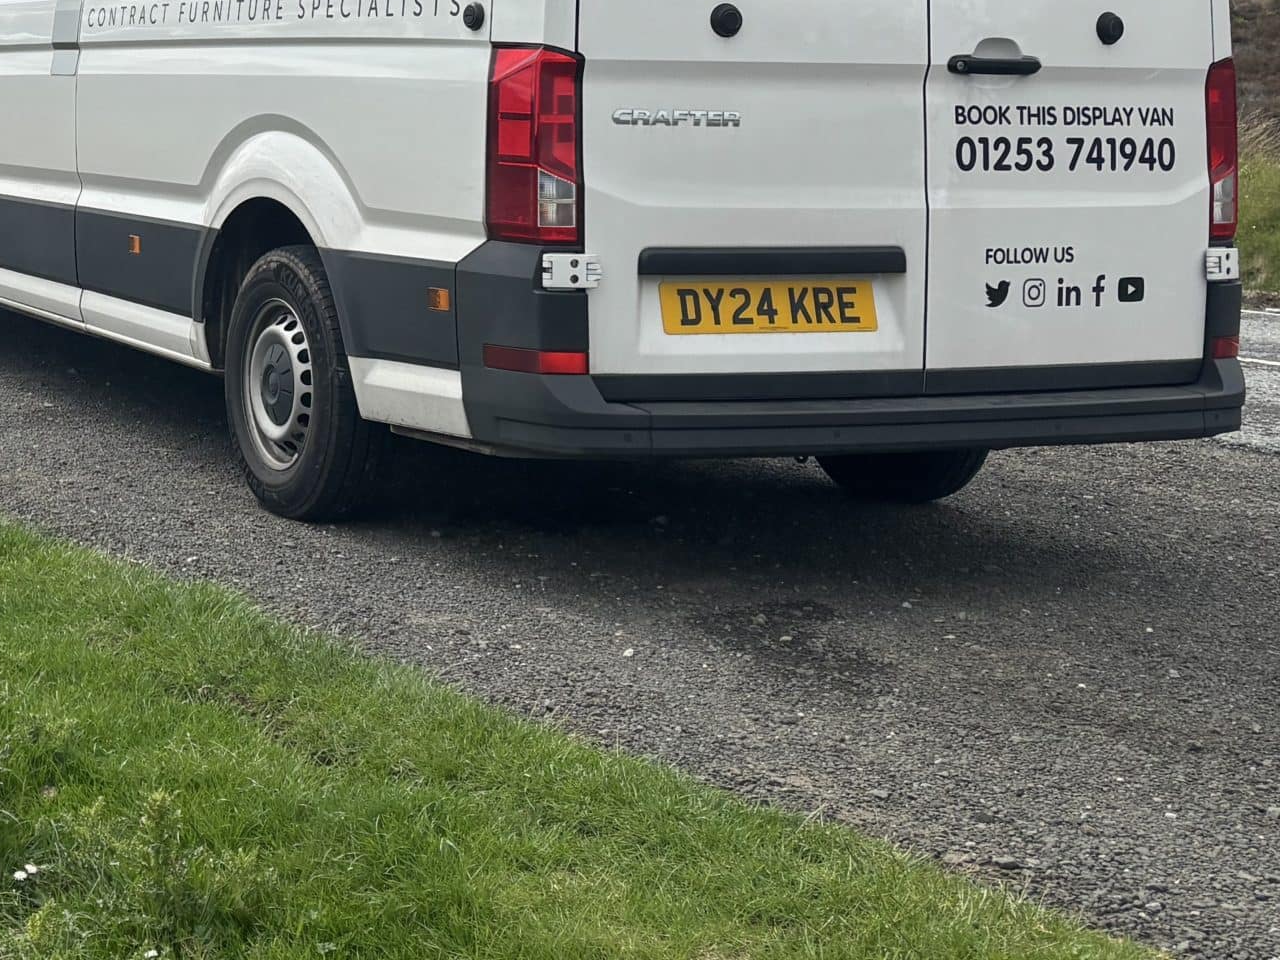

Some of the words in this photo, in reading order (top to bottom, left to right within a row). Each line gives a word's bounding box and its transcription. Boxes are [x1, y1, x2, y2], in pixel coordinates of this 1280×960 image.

[87, 3, 170, 28] CONTRACT
[611, 109, 741, 127] CRAFTER
[954, 105, 1011, 125] BOOK
[1016, 106, 1057, 125] THIS
[1063, 106, 1133, 126] DISPLAY
[1138, 107, 1174, 126] VAN
[955, 136, 1055, 172] 01253
[1066, 137, 1176, 172] 741940
[985, 248, 1049, 264] FOLLOW
[1054, 247, 1074, 263] US
[677, 288, 778, 326] DY24
[788, 287, 861, 324] KRE
